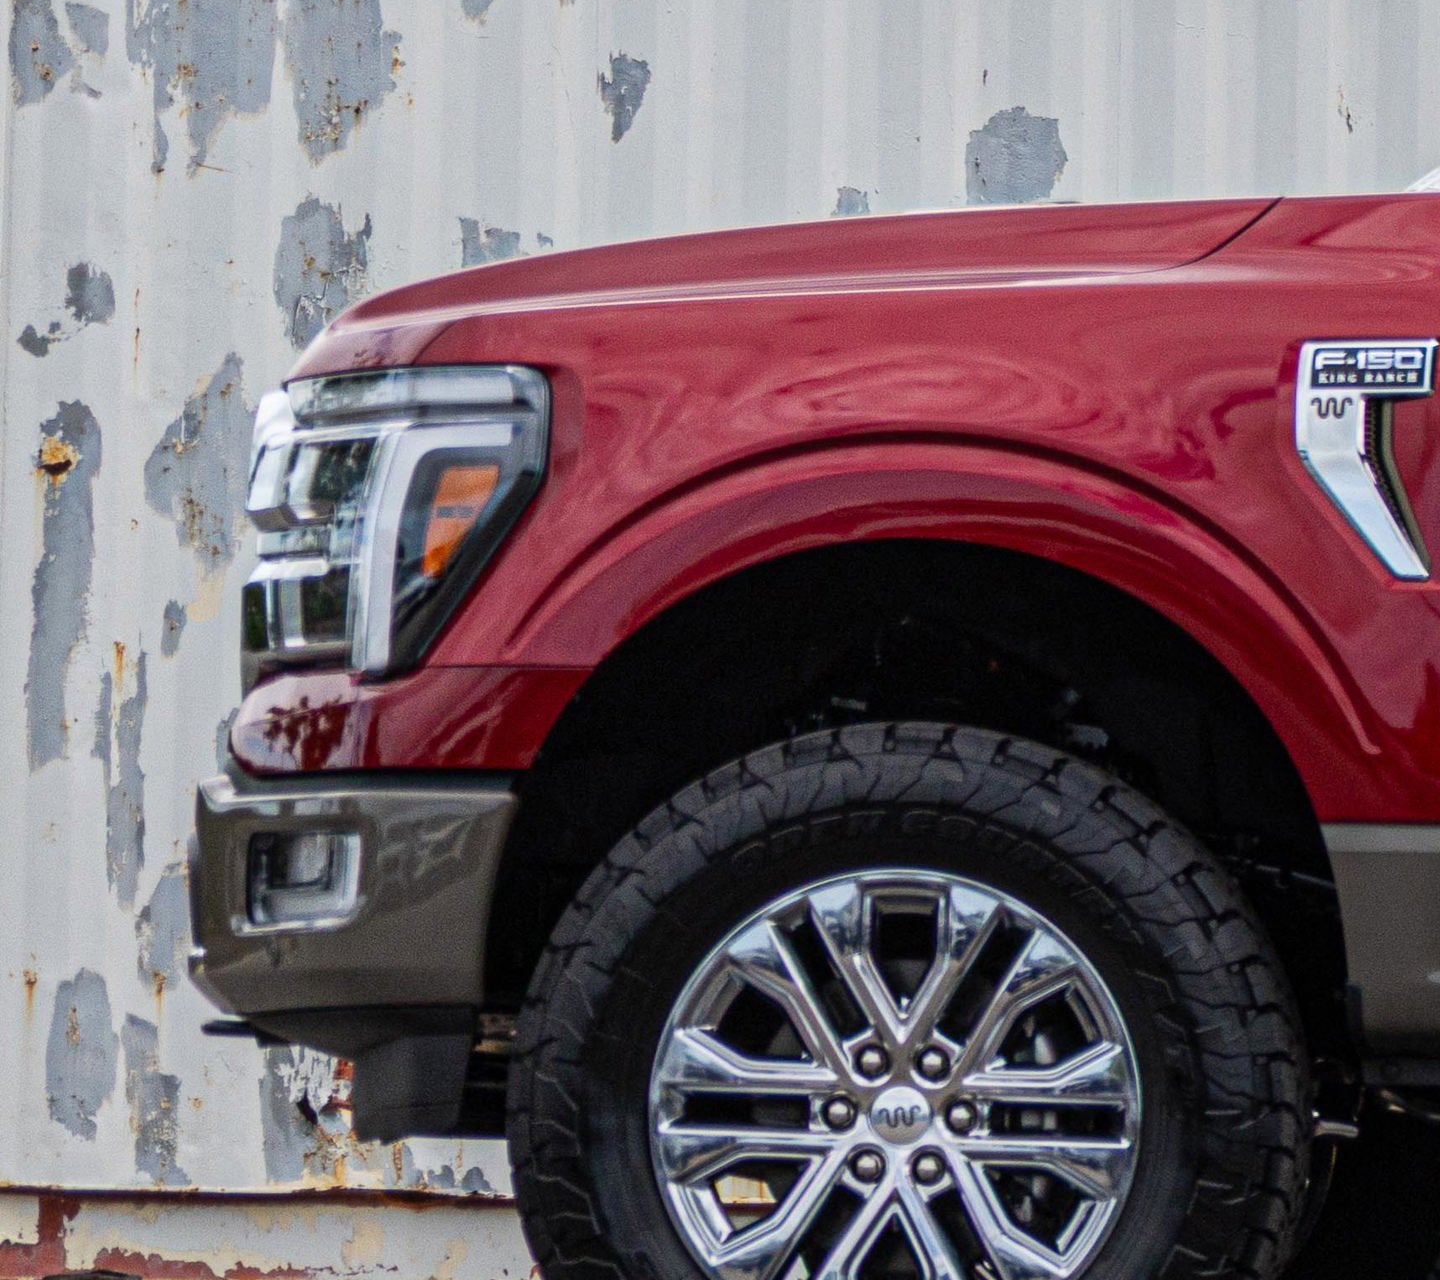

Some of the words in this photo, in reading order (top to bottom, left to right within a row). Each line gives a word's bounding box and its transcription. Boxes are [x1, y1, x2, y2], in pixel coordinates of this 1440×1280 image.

[1314, 349, 1425, 370] F-150
[1318, 372, 1358, 384] KING
[1364, 371, 1418, 384] RANCH
